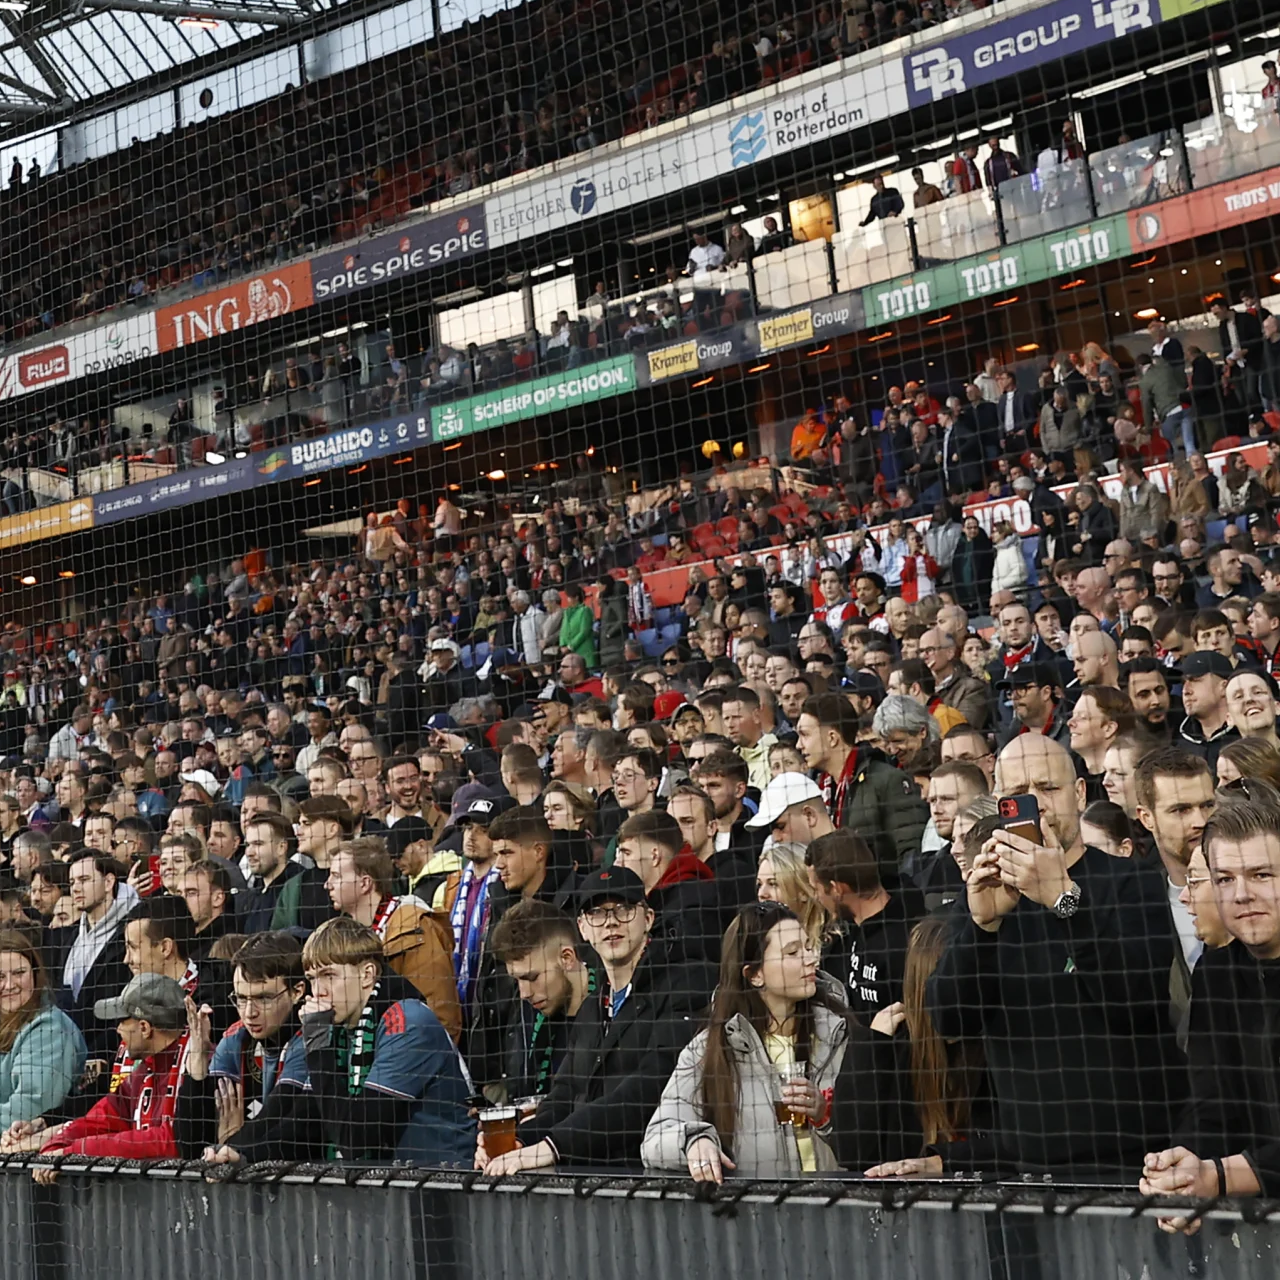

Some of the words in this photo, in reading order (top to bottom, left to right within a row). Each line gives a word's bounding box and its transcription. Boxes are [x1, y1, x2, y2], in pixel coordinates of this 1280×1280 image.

[973, 13, 1082, 69] GROUP
[773, 103, 808, 126] Port
[810, 92, 828, 115] of
[775, 106, 864, 148] Rotterdam
[493, 197, 564, 233] FLETCHER
[602, 158, 682, 198] HOTELS
[429, 228, 485, 263] SPIE
[1050, 229, 1110, 271] TOTO
[315, 265, 368, 298] SPIE
[370, 249, 425, 282] SPIE
[961, 255, 1018, 297] TOTO
[877, 280, 931, 320] TOTO
[171, 297, 241, 349] ING
[762, 319, 809, 342] Kramer
[813, 307, 850, 329] Group
[102, 346, 152, 371] WORLD
[651, 351, 695, 372] Kramer
[697, 339, 733, 360] Group
[473, 393, 533, 422] SCHERP
[534, 385, 555, 406] OP
[558, 367, 628, 400] SCHOON.
[291, 427, 374, 465] BURANDO
[438, 417, 464, 437] CSU
